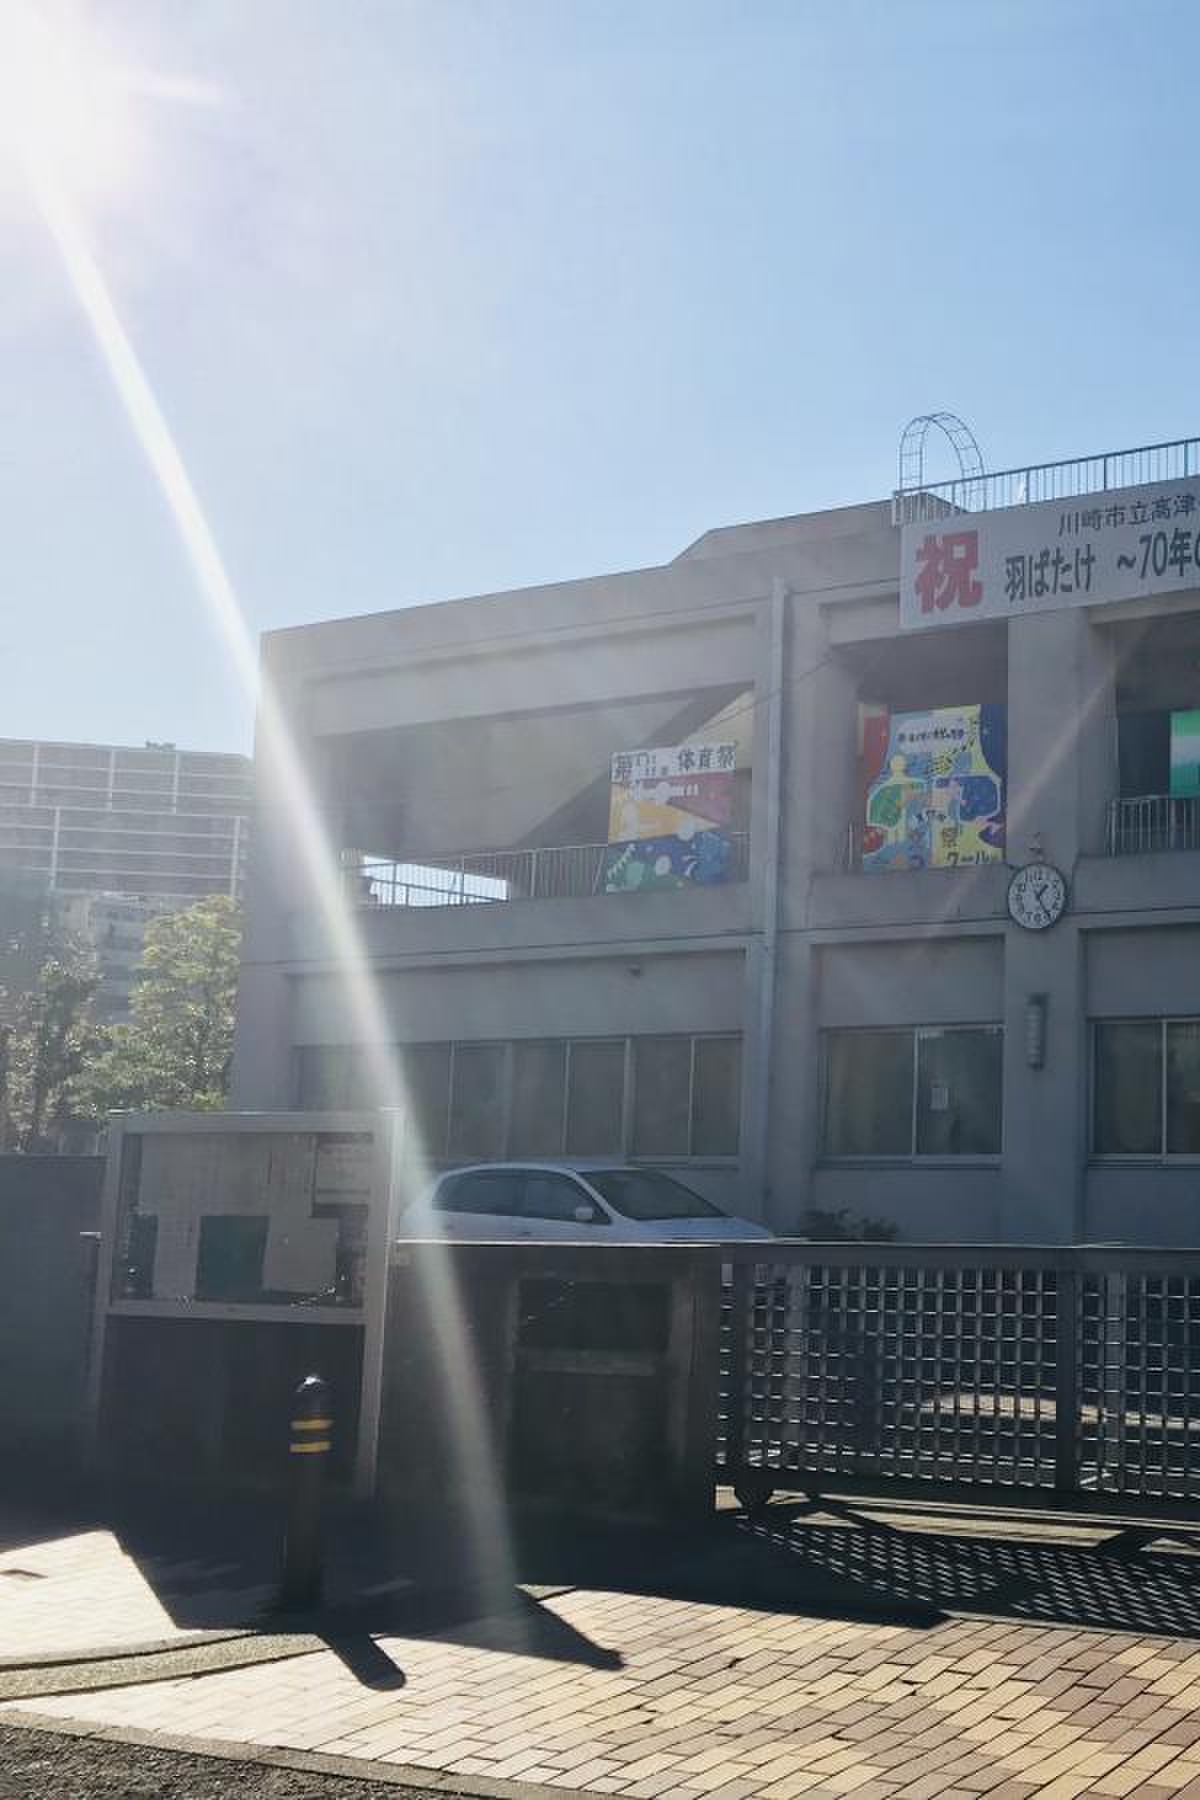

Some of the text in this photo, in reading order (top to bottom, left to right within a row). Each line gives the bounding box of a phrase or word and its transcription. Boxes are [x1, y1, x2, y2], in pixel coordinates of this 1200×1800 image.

[915, 529, 984, 614] 祝
[1005, 544, 1097, 602] 羽ばたけ
